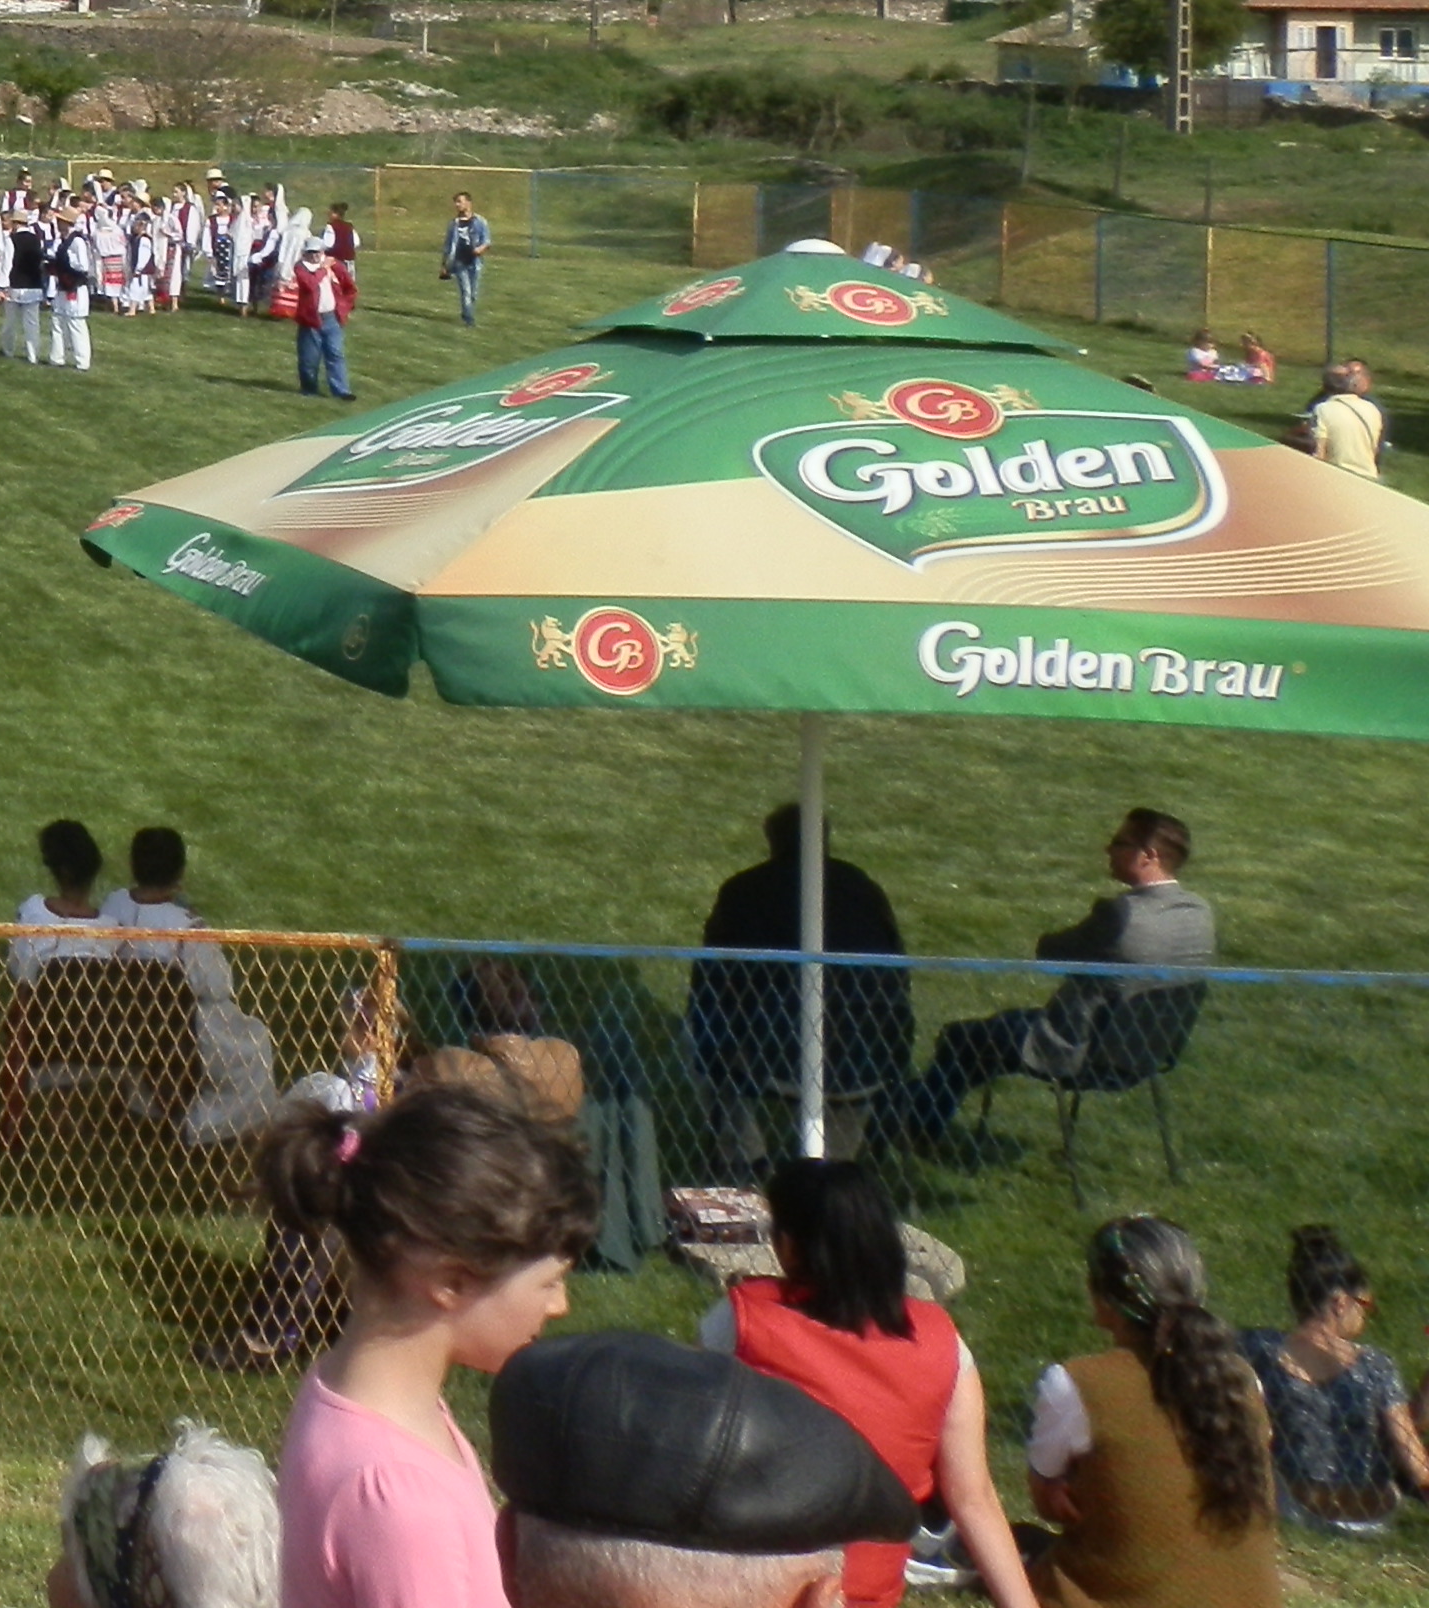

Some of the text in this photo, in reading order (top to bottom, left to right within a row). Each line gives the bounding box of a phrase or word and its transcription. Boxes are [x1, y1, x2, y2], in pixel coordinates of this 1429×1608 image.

[798, 438, 1176, 516] Golden
[1010, 494, 1128, 522] Brau
[917, 620, 1285, 700] Golden Brau
